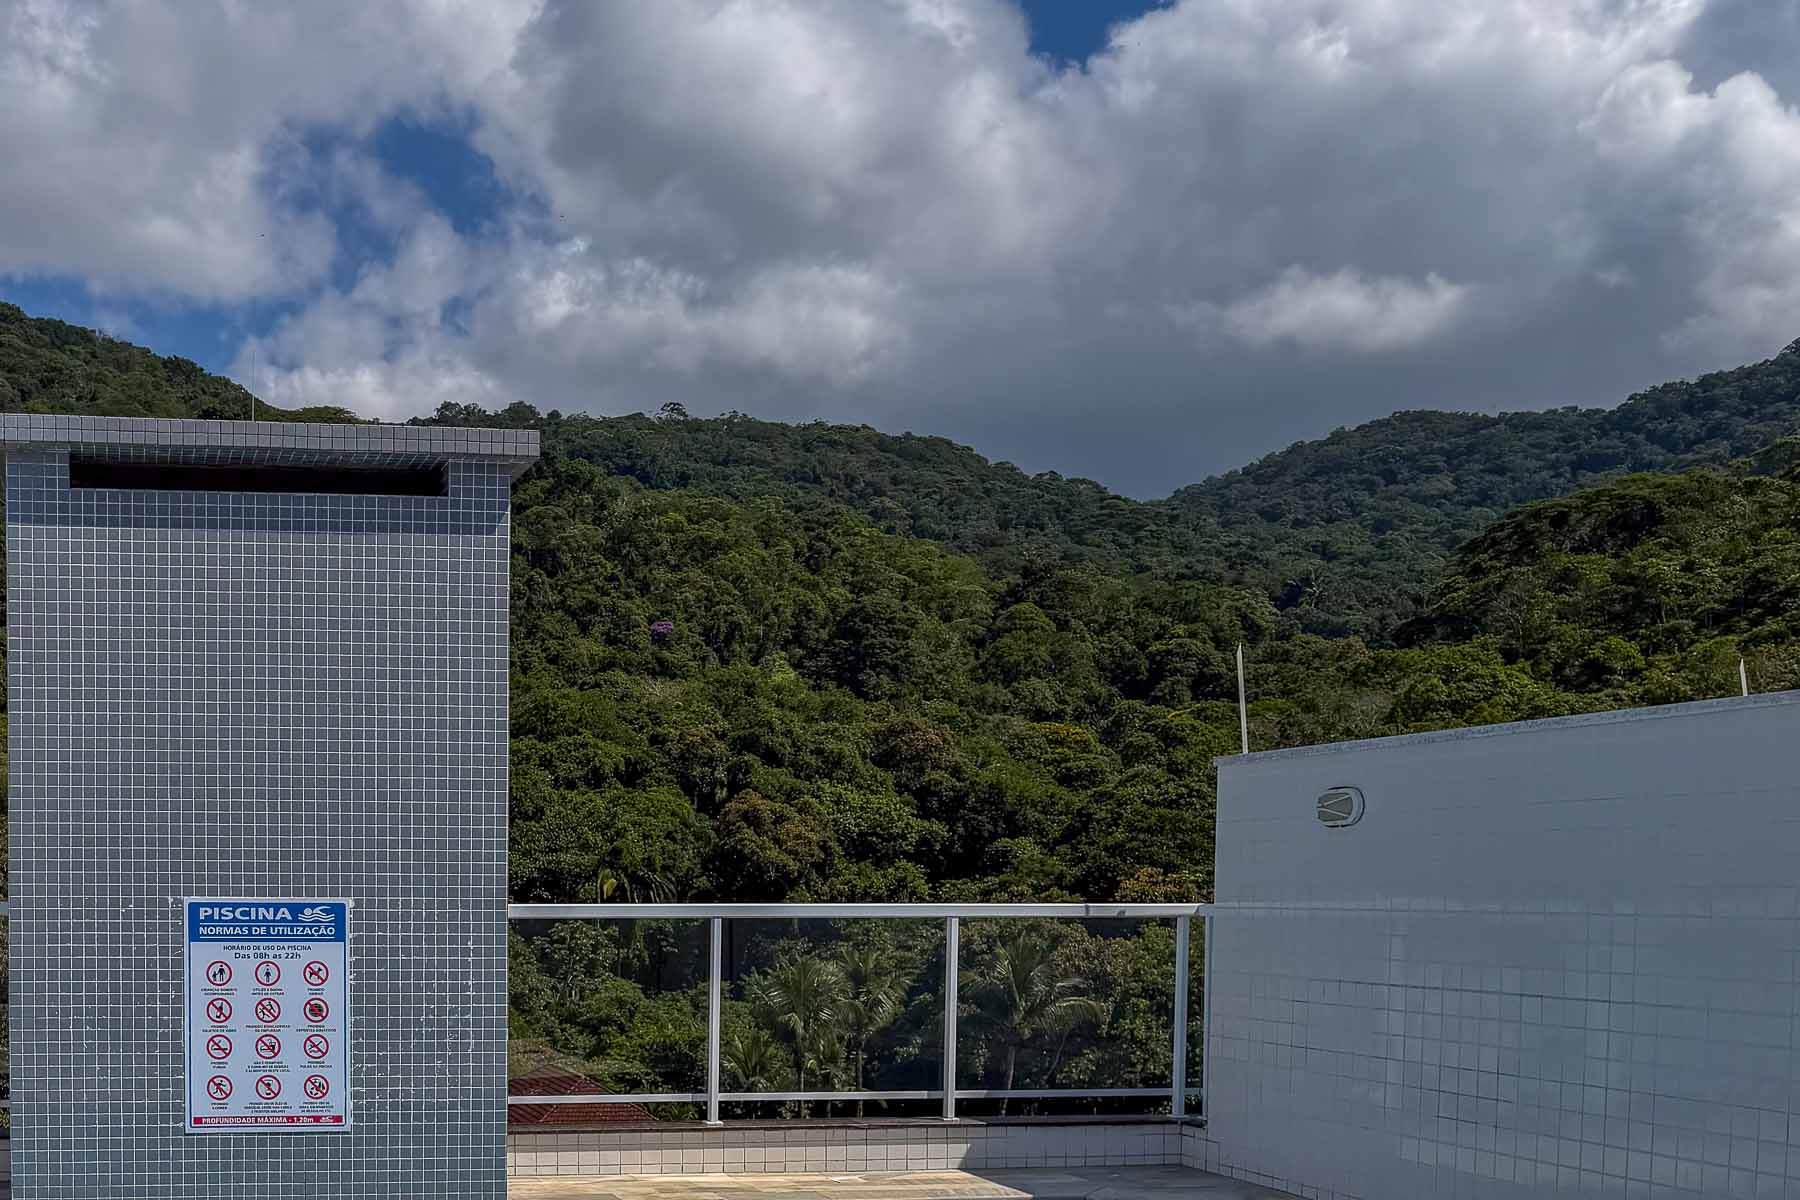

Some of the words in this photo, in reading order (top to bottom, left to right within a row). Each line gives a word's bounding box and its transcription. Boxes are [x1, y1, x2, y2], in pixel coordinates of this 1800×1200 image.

[199, 907, 293, 920] PISCINA
[199, 926, 249, 935] NORMAS
[252, 926, 267, 935] DE
[270, 925, 335, 937] UTILIZAÇÃO
[234, 952, 252, 960] Das
[253, 952, 270, 960] 08h
[285, 952, 301, 960] 22h
[202, 1117, 256, 1125] PROFUNDIDADE
[257, 1116, 288, 1124] MÁXIMA
